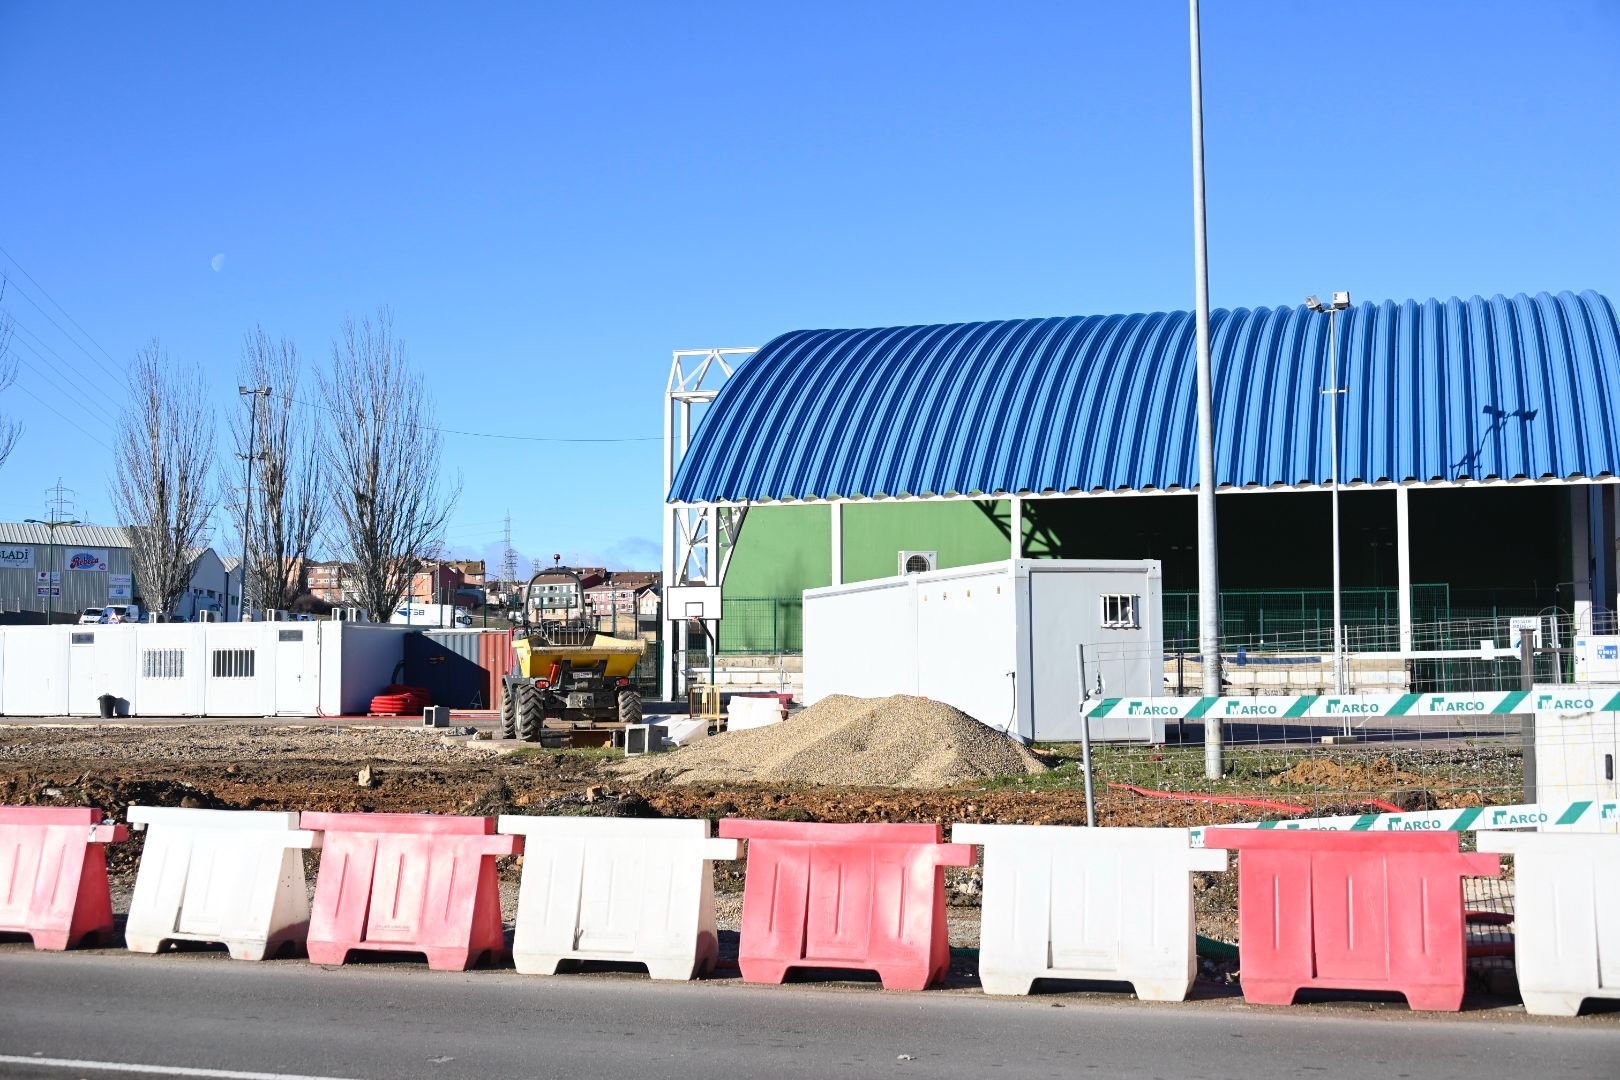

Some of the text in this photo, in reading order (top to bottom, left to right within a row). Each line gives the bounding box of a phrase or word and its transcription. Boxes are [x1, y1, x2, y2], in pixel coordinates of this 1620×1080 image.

[70, 555, 99, 569] Rebeca
[1128, 702, 1178, 715] MARCO
[1225, 701, 1277, 715] MARCO
[1326, 699, 1379, 713] MARCO
[1430, 698, 1484, 712] MARCO
[1538, 695, 1593, 710] MARCO
[1387, 817, 1442, 832] MARCO
[1492, 810, 1548, 825] MARCO
